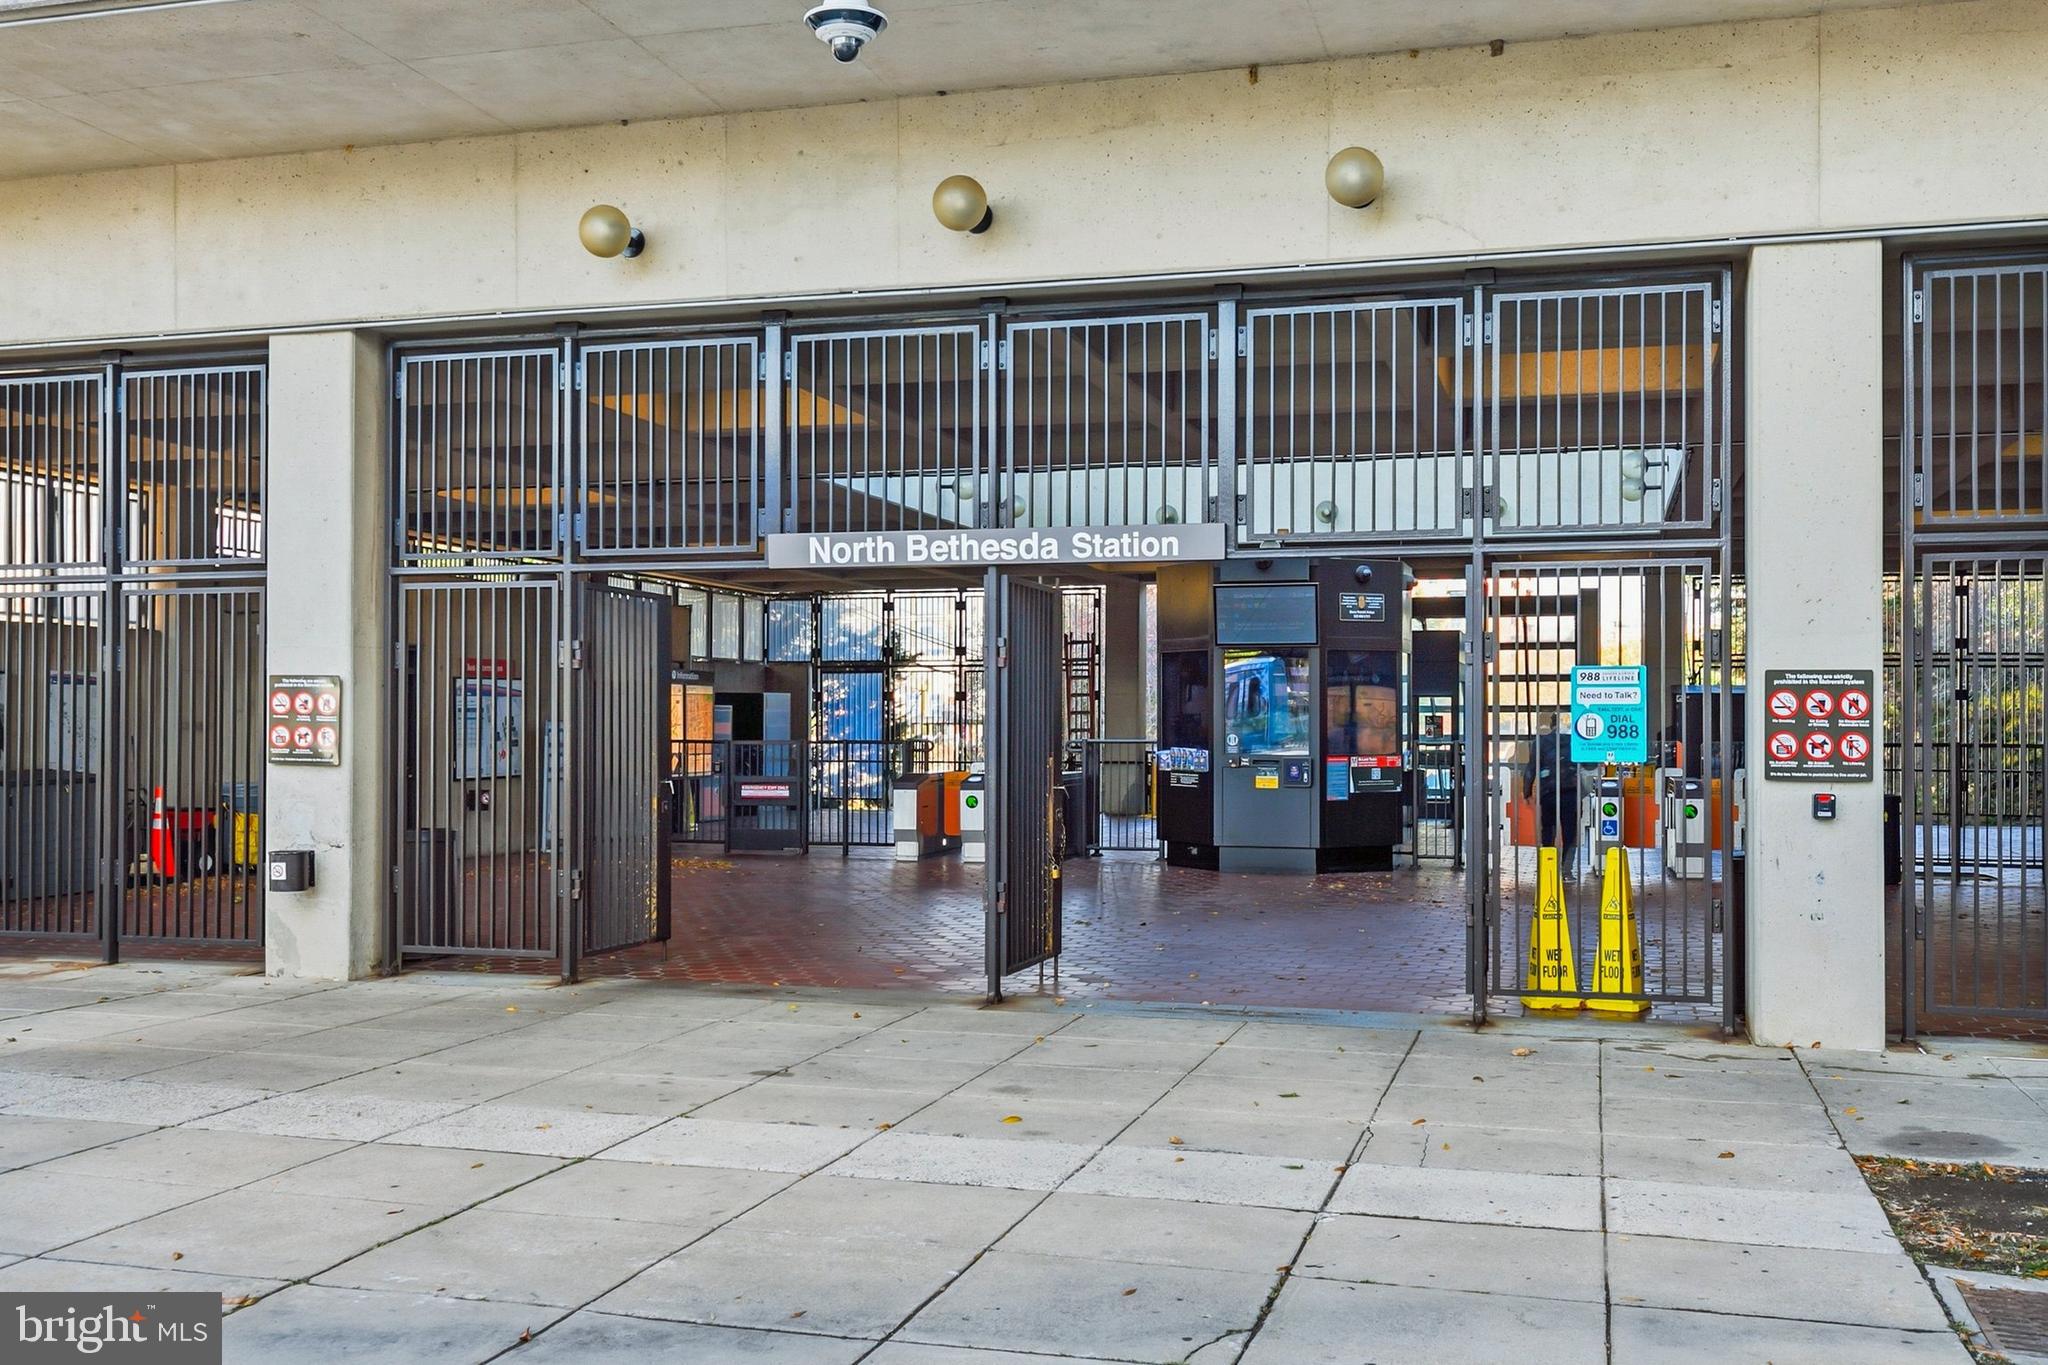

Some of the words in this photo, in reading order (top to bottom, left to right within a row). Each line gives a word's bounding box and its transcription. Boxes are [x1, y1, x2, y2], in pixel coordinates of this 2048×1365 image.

[808, 535, 896, 564] North
[906, 532, 1059, 562] Bethesda
[1071, 531, 1180, 559] Station
[1579, 671, 1601, 682] 988
[1579, 691, 1602, 700] Need
[1604, 691, 1613, 700] to
[1614, 691, 1638, 700] Talk?
[1610, 714, 1635, 723] DIAL
[1606, 724, 1640, 739] 988
[1604, 949, 1621, 962] WET
